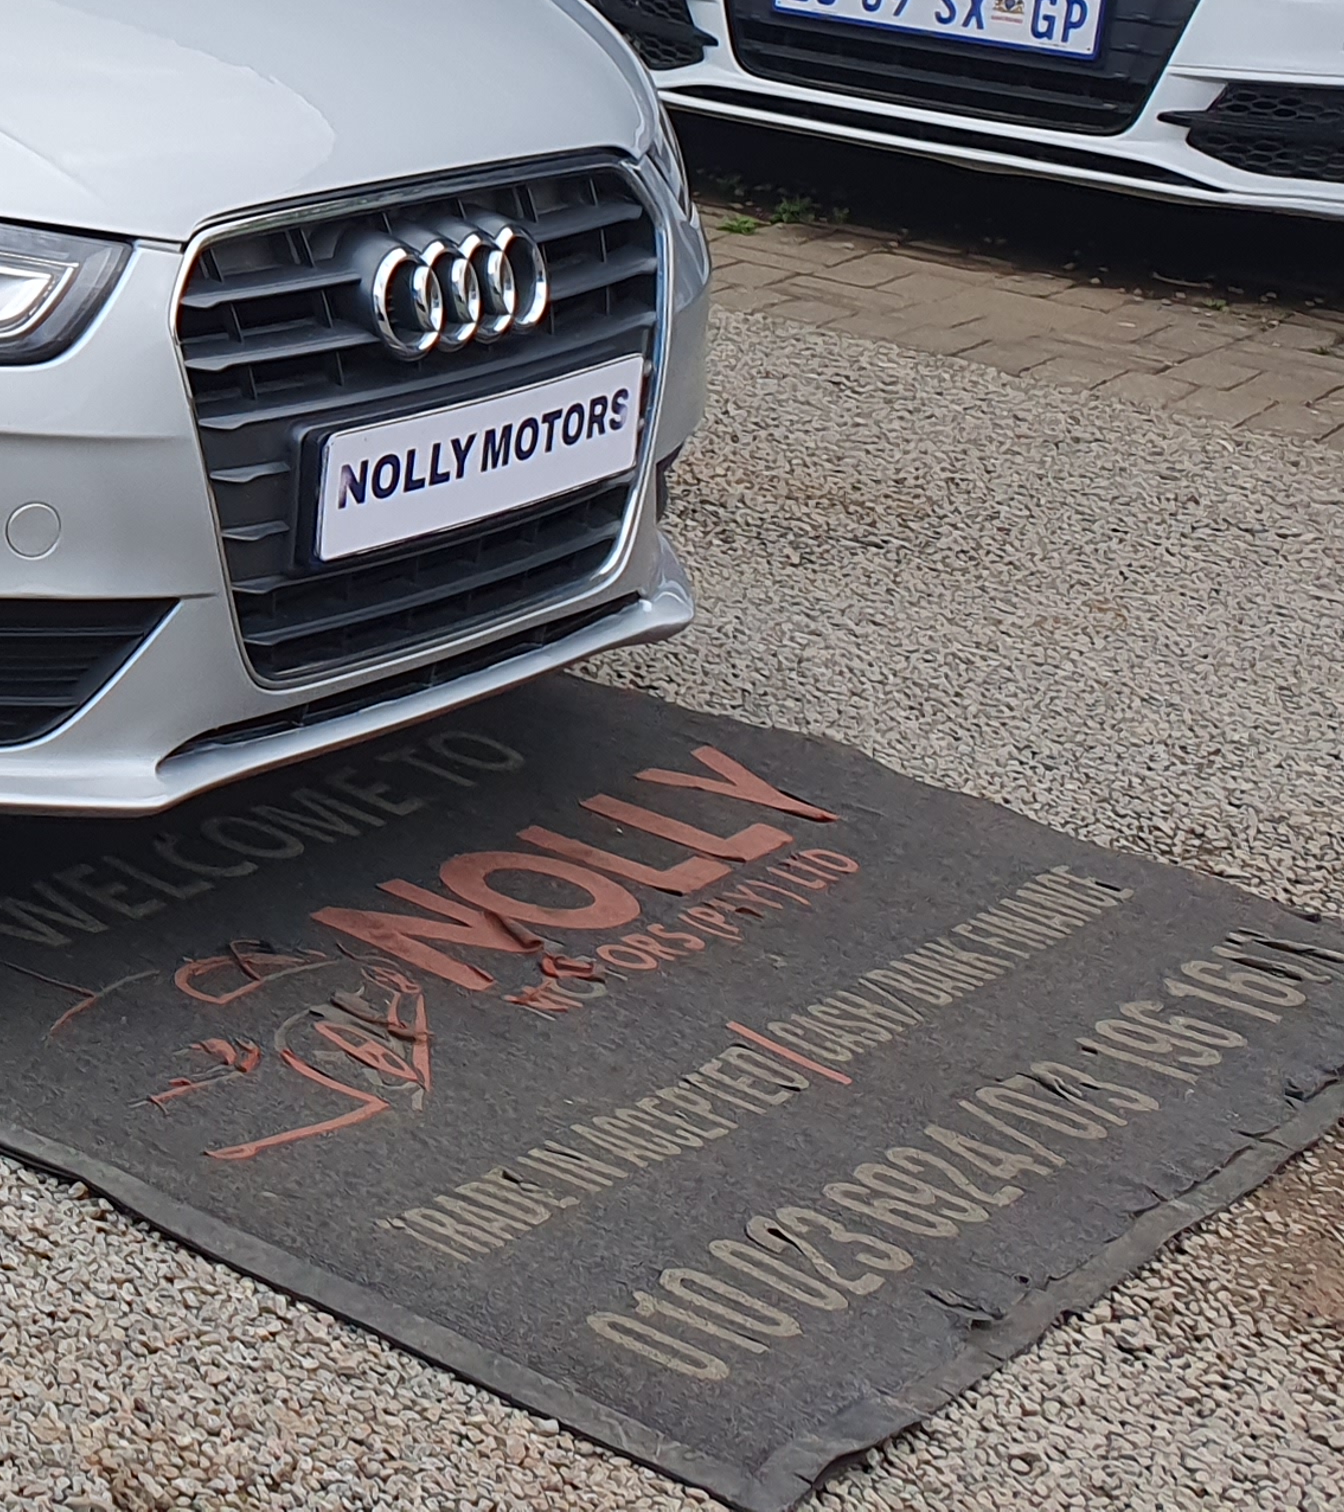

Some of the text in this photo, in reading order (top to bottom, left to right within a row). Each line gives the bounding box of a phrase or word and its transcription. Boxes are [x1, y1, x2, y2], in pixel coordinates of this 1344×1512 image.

[337, 387, 630, 510] NOLLY MOTORS
[375, 729, 527, 789] TO
[310, 745, 840, 992] NOLLY
[766, 848, 861, 890] LTD
[951, 864, 1135, 960] FINANCE
[569, 1044, 811, 1169] ACCEPTED
[374, 1164, 581, 1263] TRADE
[516, 1139, 629, 1192] IN
[586, 1267, 804, 1380] 010
[708, 1206, 913, 1311] 023
[1074, 999, 1249, 1085] 196
